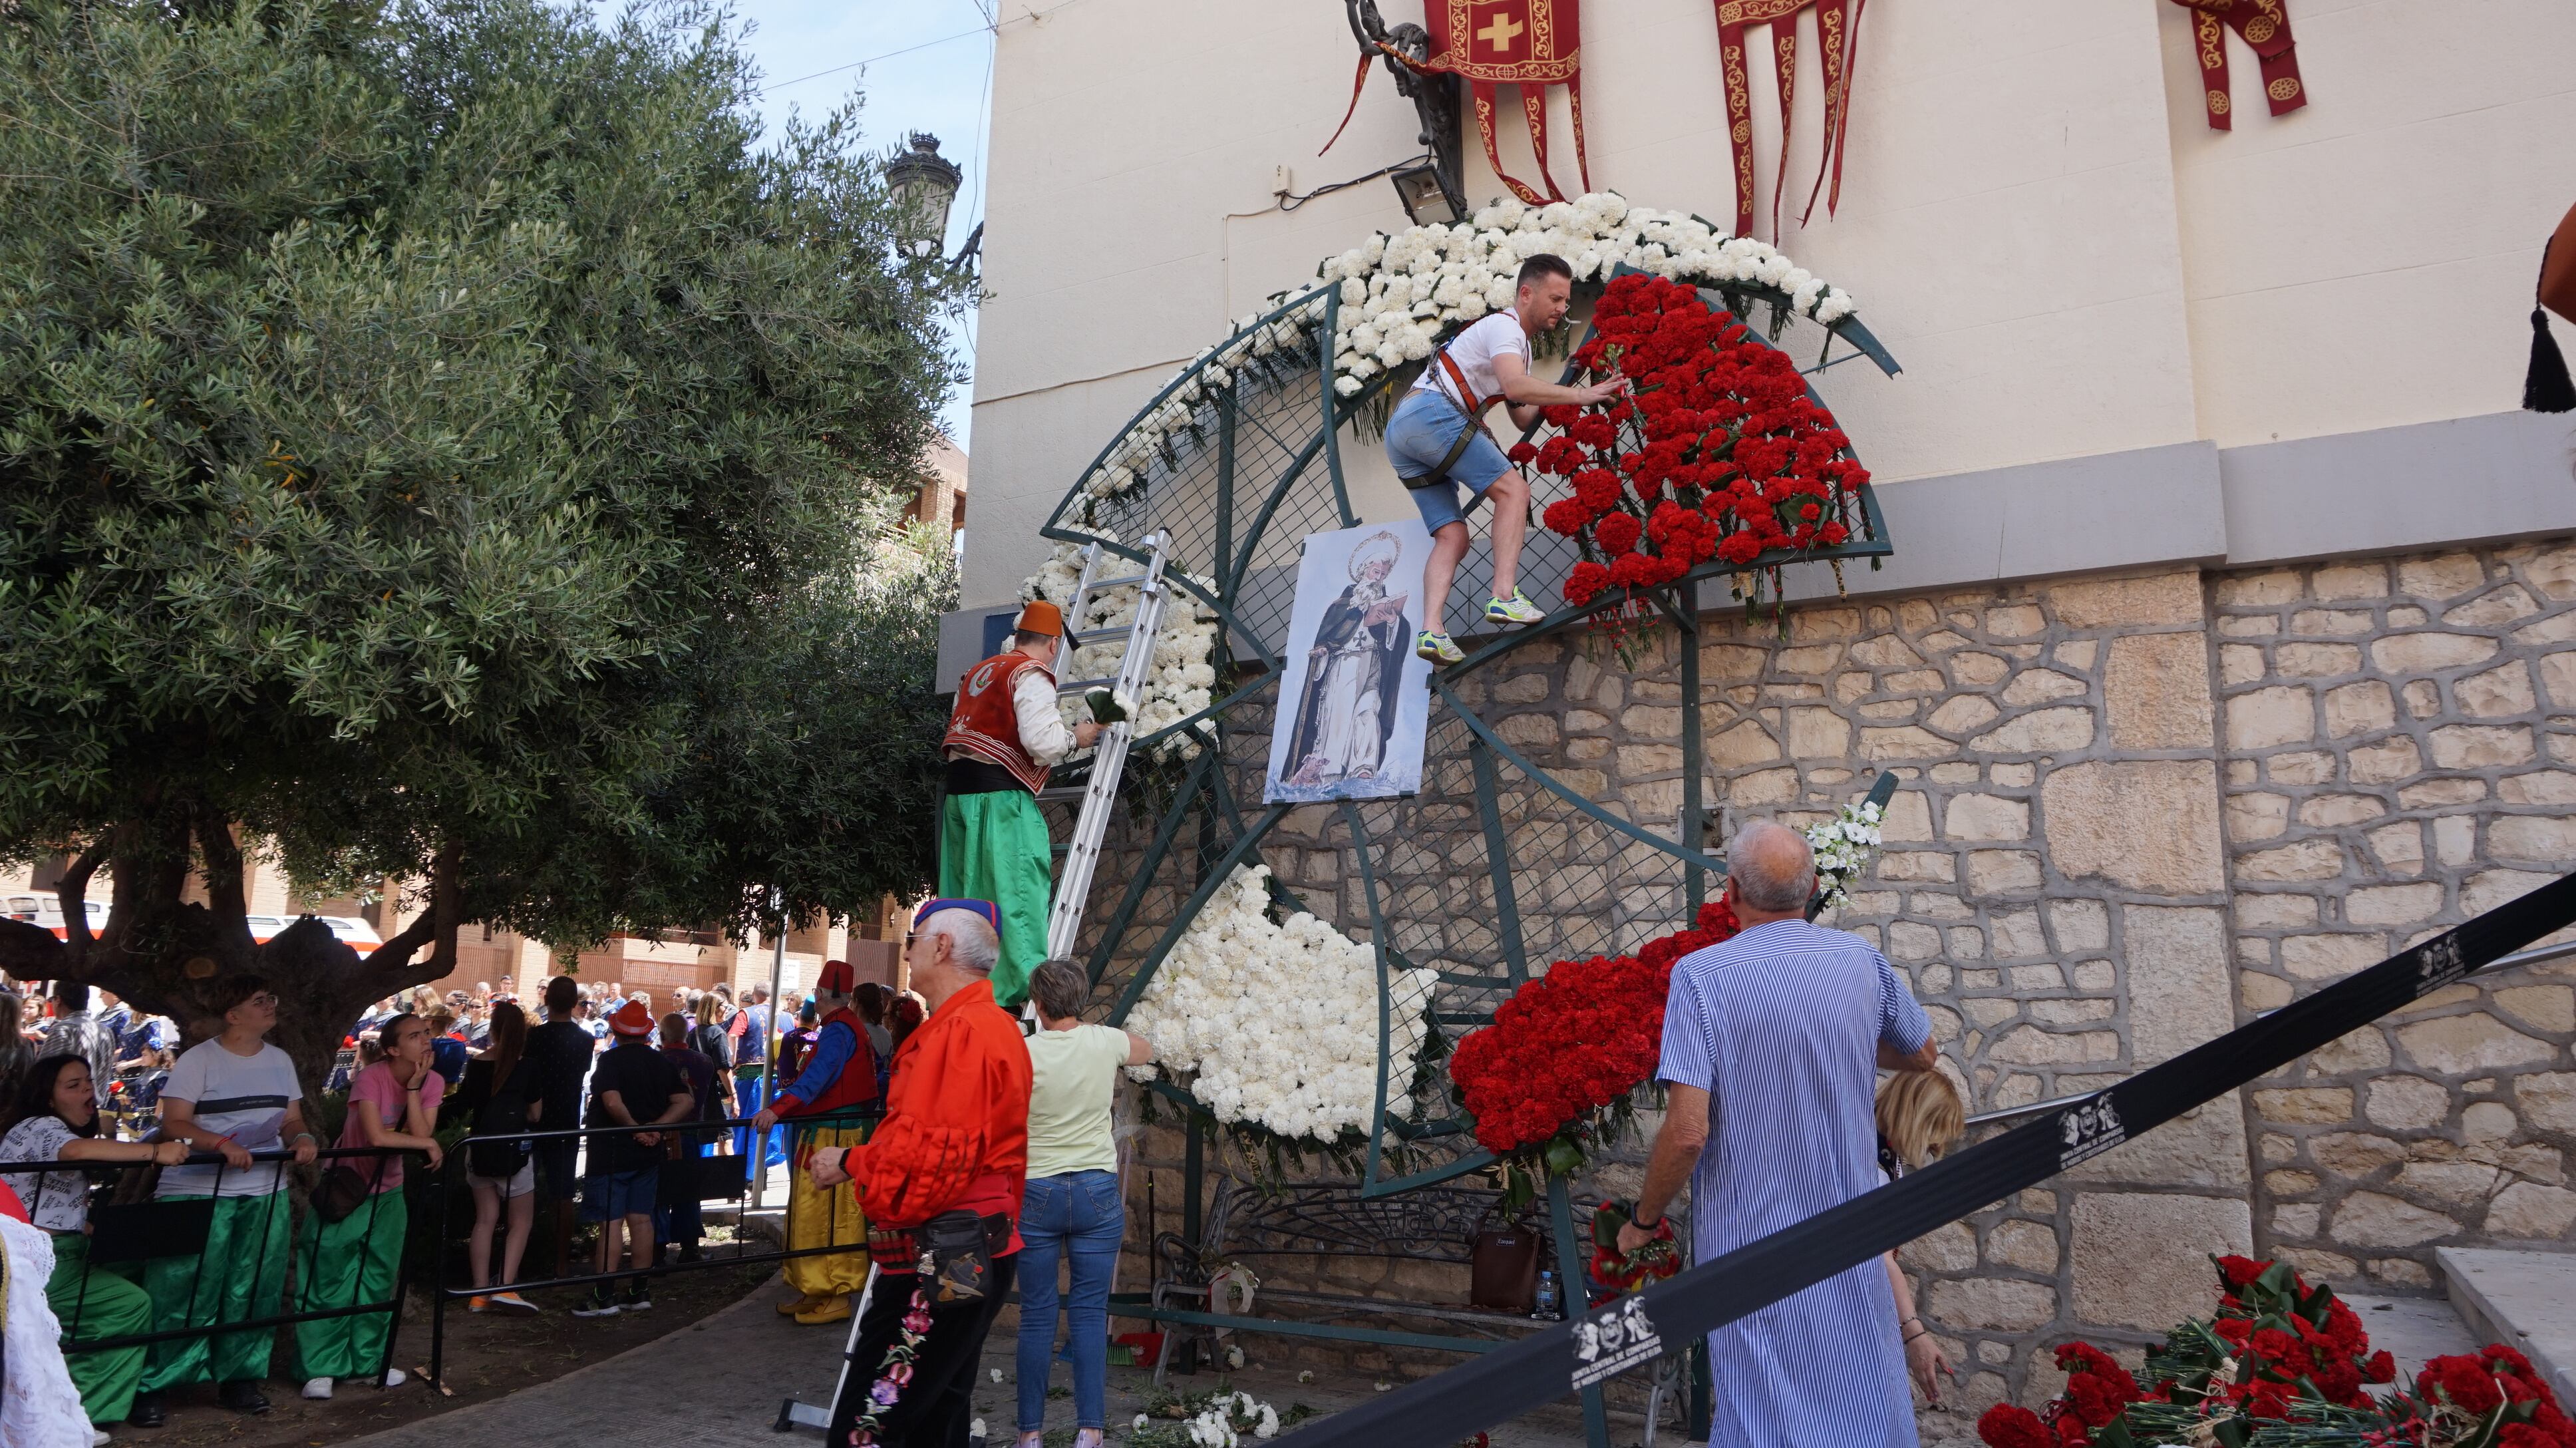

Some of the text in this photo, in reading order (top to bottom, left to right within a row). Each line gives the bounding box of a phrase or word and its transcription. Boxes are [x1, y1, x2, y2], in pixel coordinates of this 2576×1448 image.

[1571, 1335, 1661, 1381] JUNTA CENTRAL DE COMPARSAS
[1571, 1379, 1581, 1391] DE
[1581, 1371, 1603, 1387] MOROS
[1601, 1369, 1607, 1378] Y
[1605, 1354, 1641, 1376] CRISTIANOS
[1639, 1351, 1648, 1361] DE
